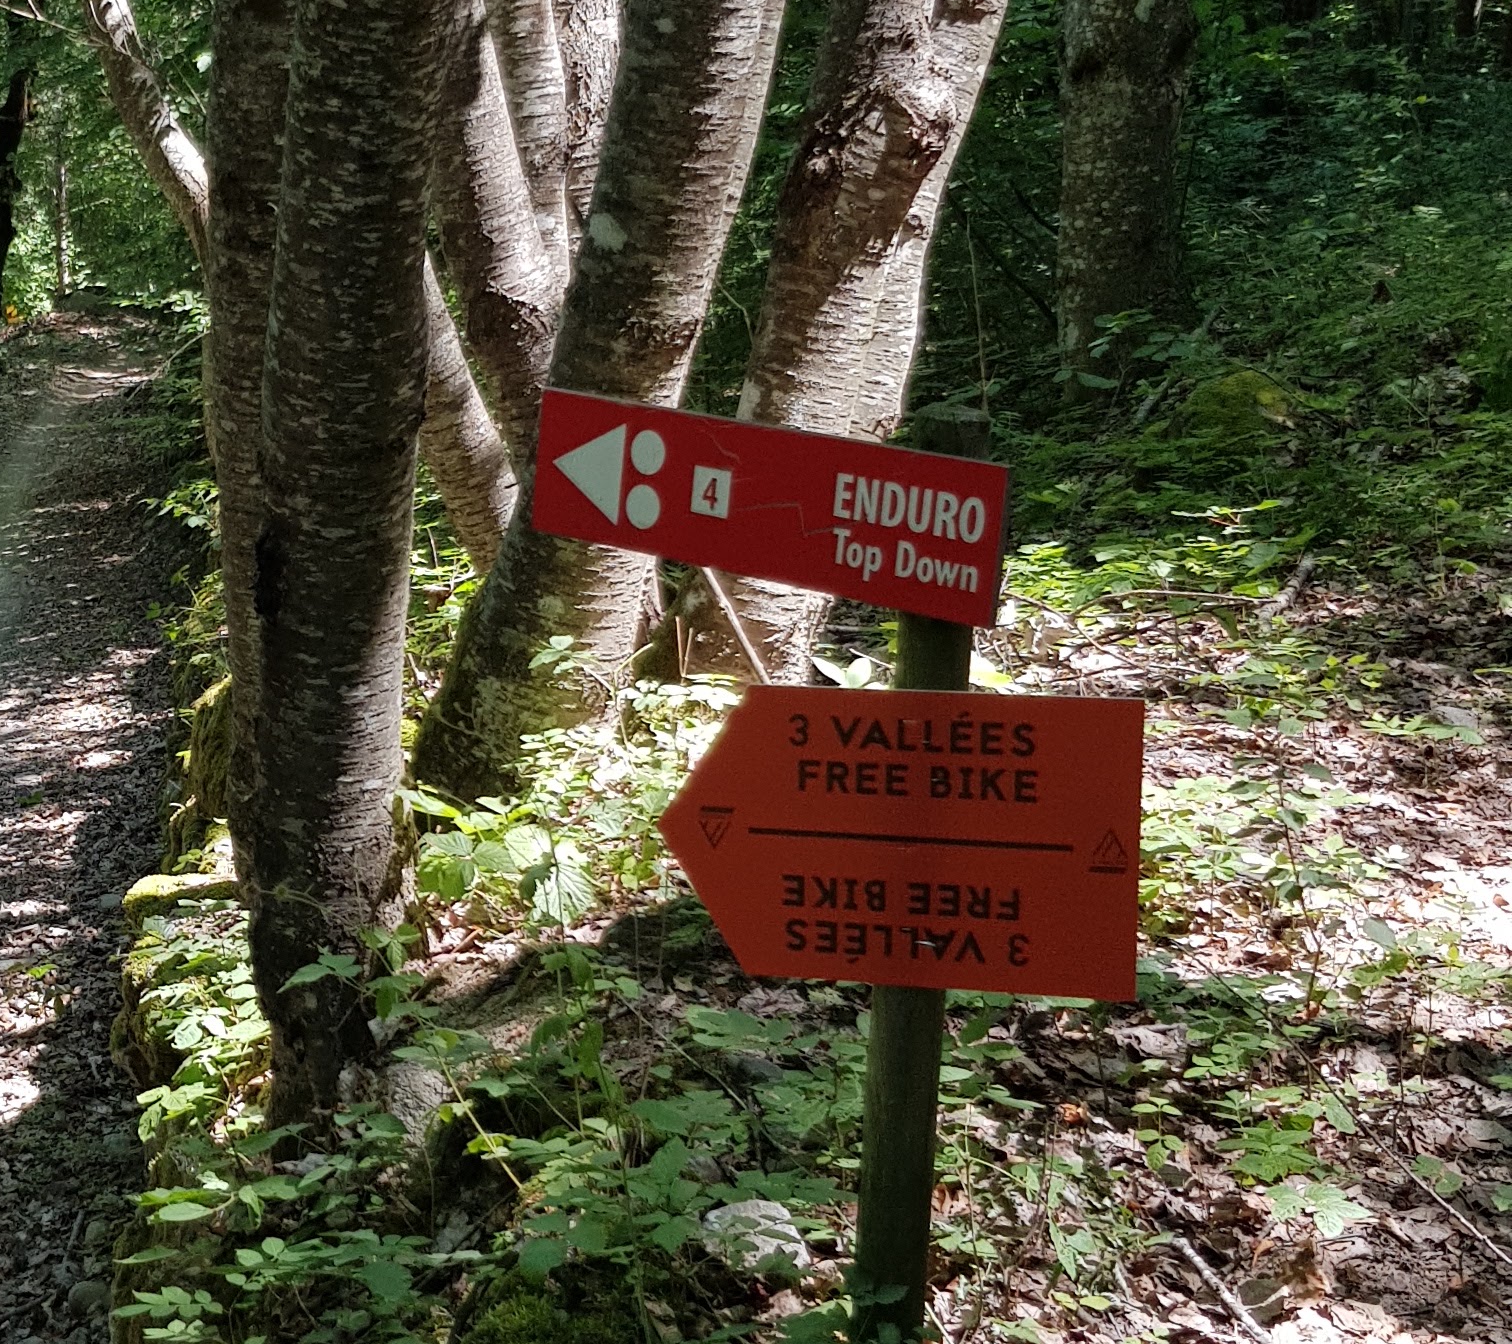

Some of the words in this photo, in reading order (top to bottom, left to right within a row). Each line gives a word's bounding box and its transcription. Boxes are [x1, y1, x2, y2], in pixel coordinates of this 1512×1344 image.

[701, 477, 718, 511] 4
[832, 472, 986, 544] ENDURO
[832, 527, 882, 582] Top
[894, 540, 978, 593] Down
[789, 714, 809, 747] 3
[831, 711, 1037, 757] VALLÉES
[796, 760, 908, 795] FREE
[930, 765, 1039, 803] BIKE
[781, 874, 887, 910] BIKE
[909, 882, 1020, 921] FREE
[785, 919, 986, 965] VALLÉES
[1007, 933, 1030, 966] 3
